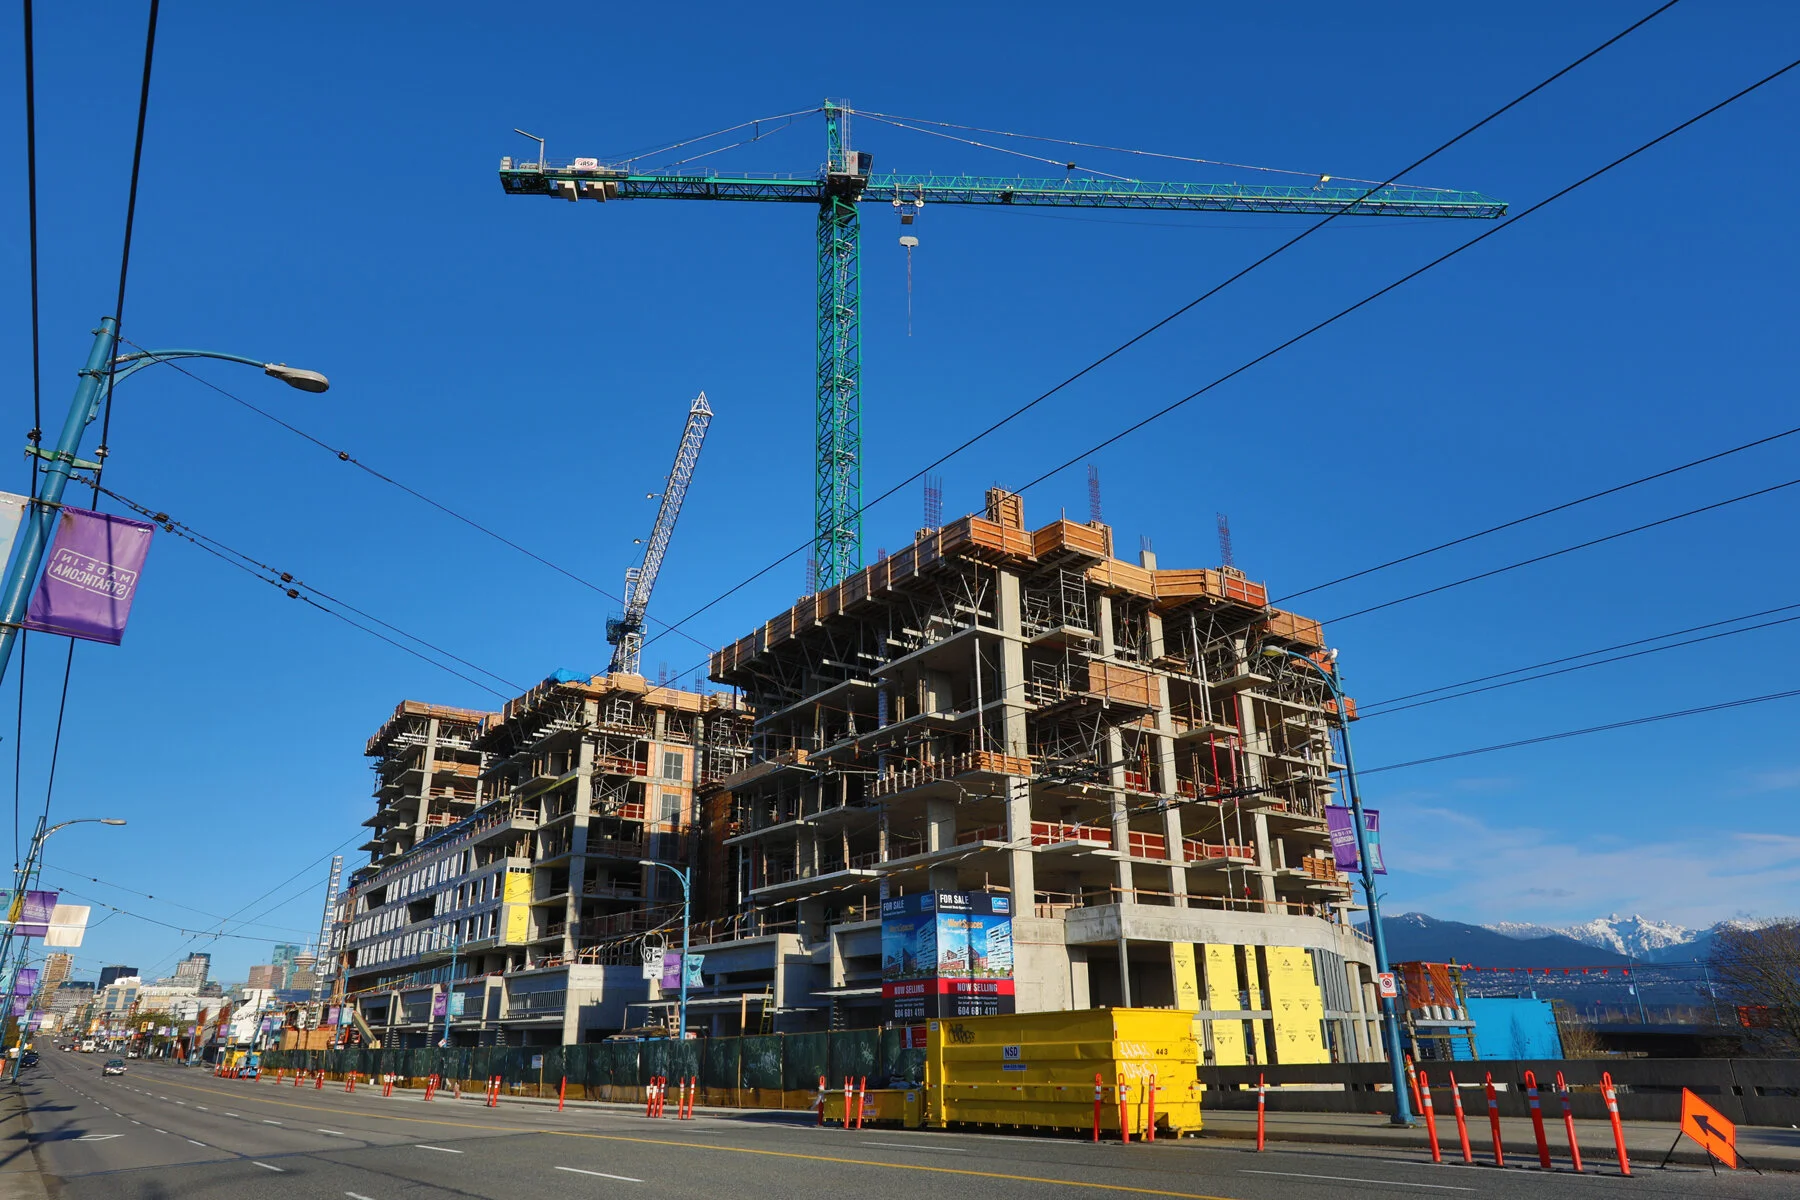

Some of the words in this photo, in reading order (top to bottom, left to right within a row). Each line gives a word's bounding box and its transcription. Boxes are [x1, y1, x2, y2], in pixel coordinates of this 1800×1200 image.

[940, 894, 953, 904] FOR
[954, 895, 970, 905] SALE
[883, 901, 893, 911] FOR
[893, 900, 904, 910] SALE
[894, 986, 905, 995] NOW
[906, 984, 925, 994] SELLING
[957, 983, 972, 992] NOW
[973, 983, 998, 992] SELLING
[957, 1006, 970, 1015] 604
[984, 1006, 998, 1016] 4111
[1004, 1046, 1018, 1057] NSD
